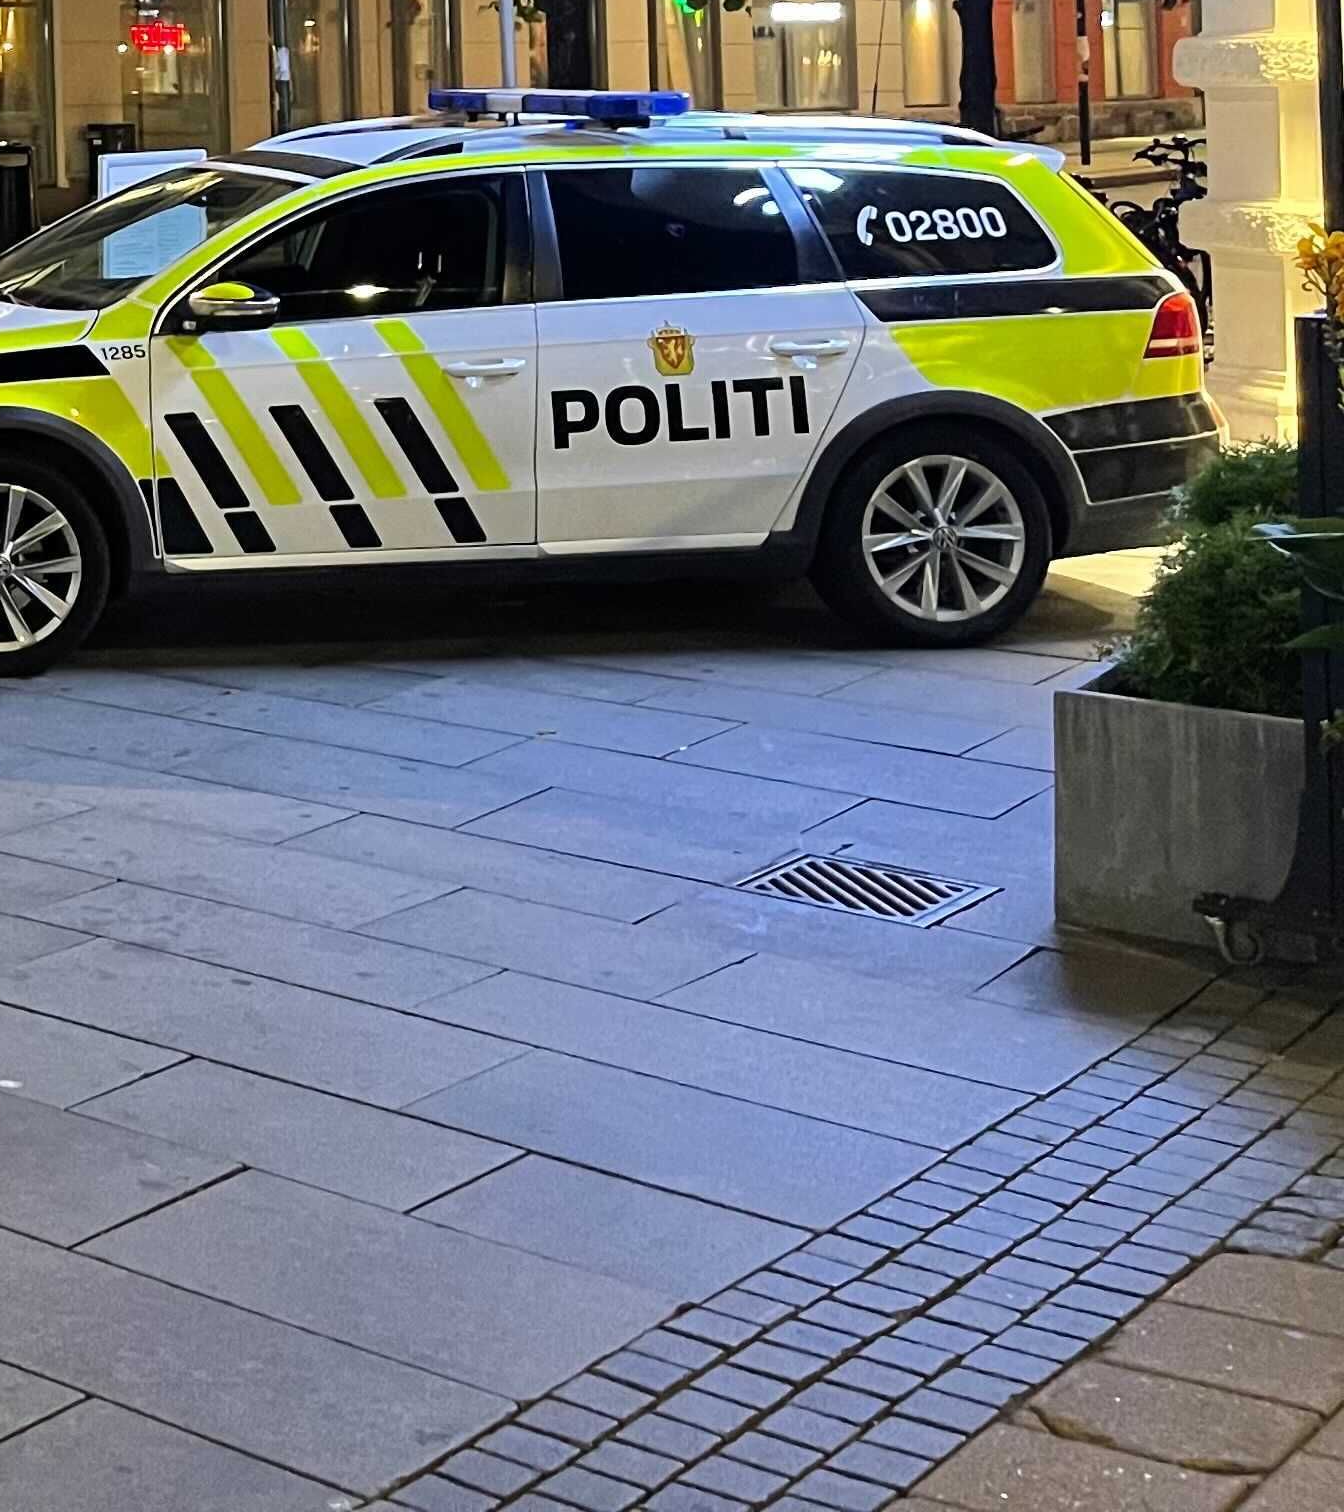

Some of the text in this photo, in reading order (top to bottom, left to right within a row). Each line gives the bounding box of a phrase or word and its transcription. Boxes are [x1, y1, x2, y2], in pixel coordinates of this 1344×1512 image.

[885, 205, 1008, 244] 02800
[100, 344, 146, 361] 1285
[550, 374, 810, 450] POLITI
